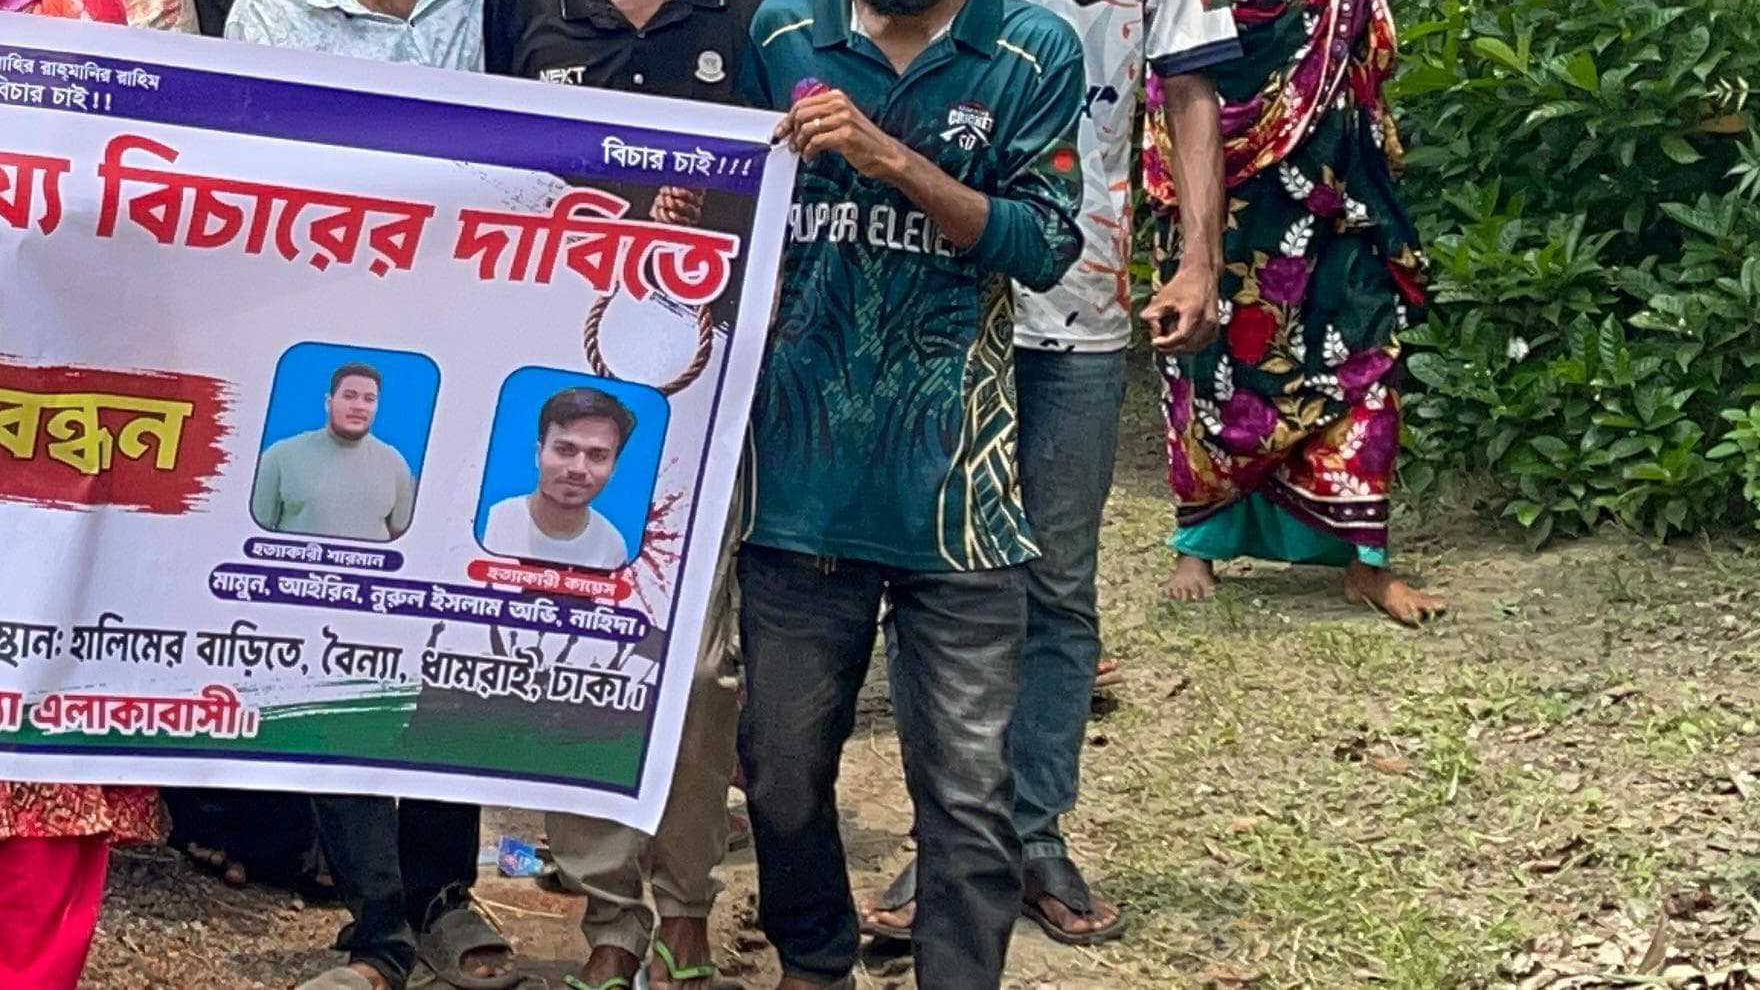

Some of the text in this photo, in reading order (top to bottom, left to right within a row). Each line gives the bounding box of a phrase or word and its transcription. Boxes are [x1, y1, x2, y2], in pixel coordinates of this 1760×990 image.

[115, 67, 161, 91] রাহিম
[540, 66, 587, 85] NEXT
[601, 136, 667, 171] বিচার
[96, 135, 434, 277] বিচারের
[453, 187, 735, 303] দাবিতে
[868, 204, 956, 258] ELEVE
[251, 541, 324, 562] হত্যাকারী
[487, 566, 561, 589] হত্যাকারী
[430, 586, 503, 618] ইসলাম
[69, 612, 188, 669] হালিমের
